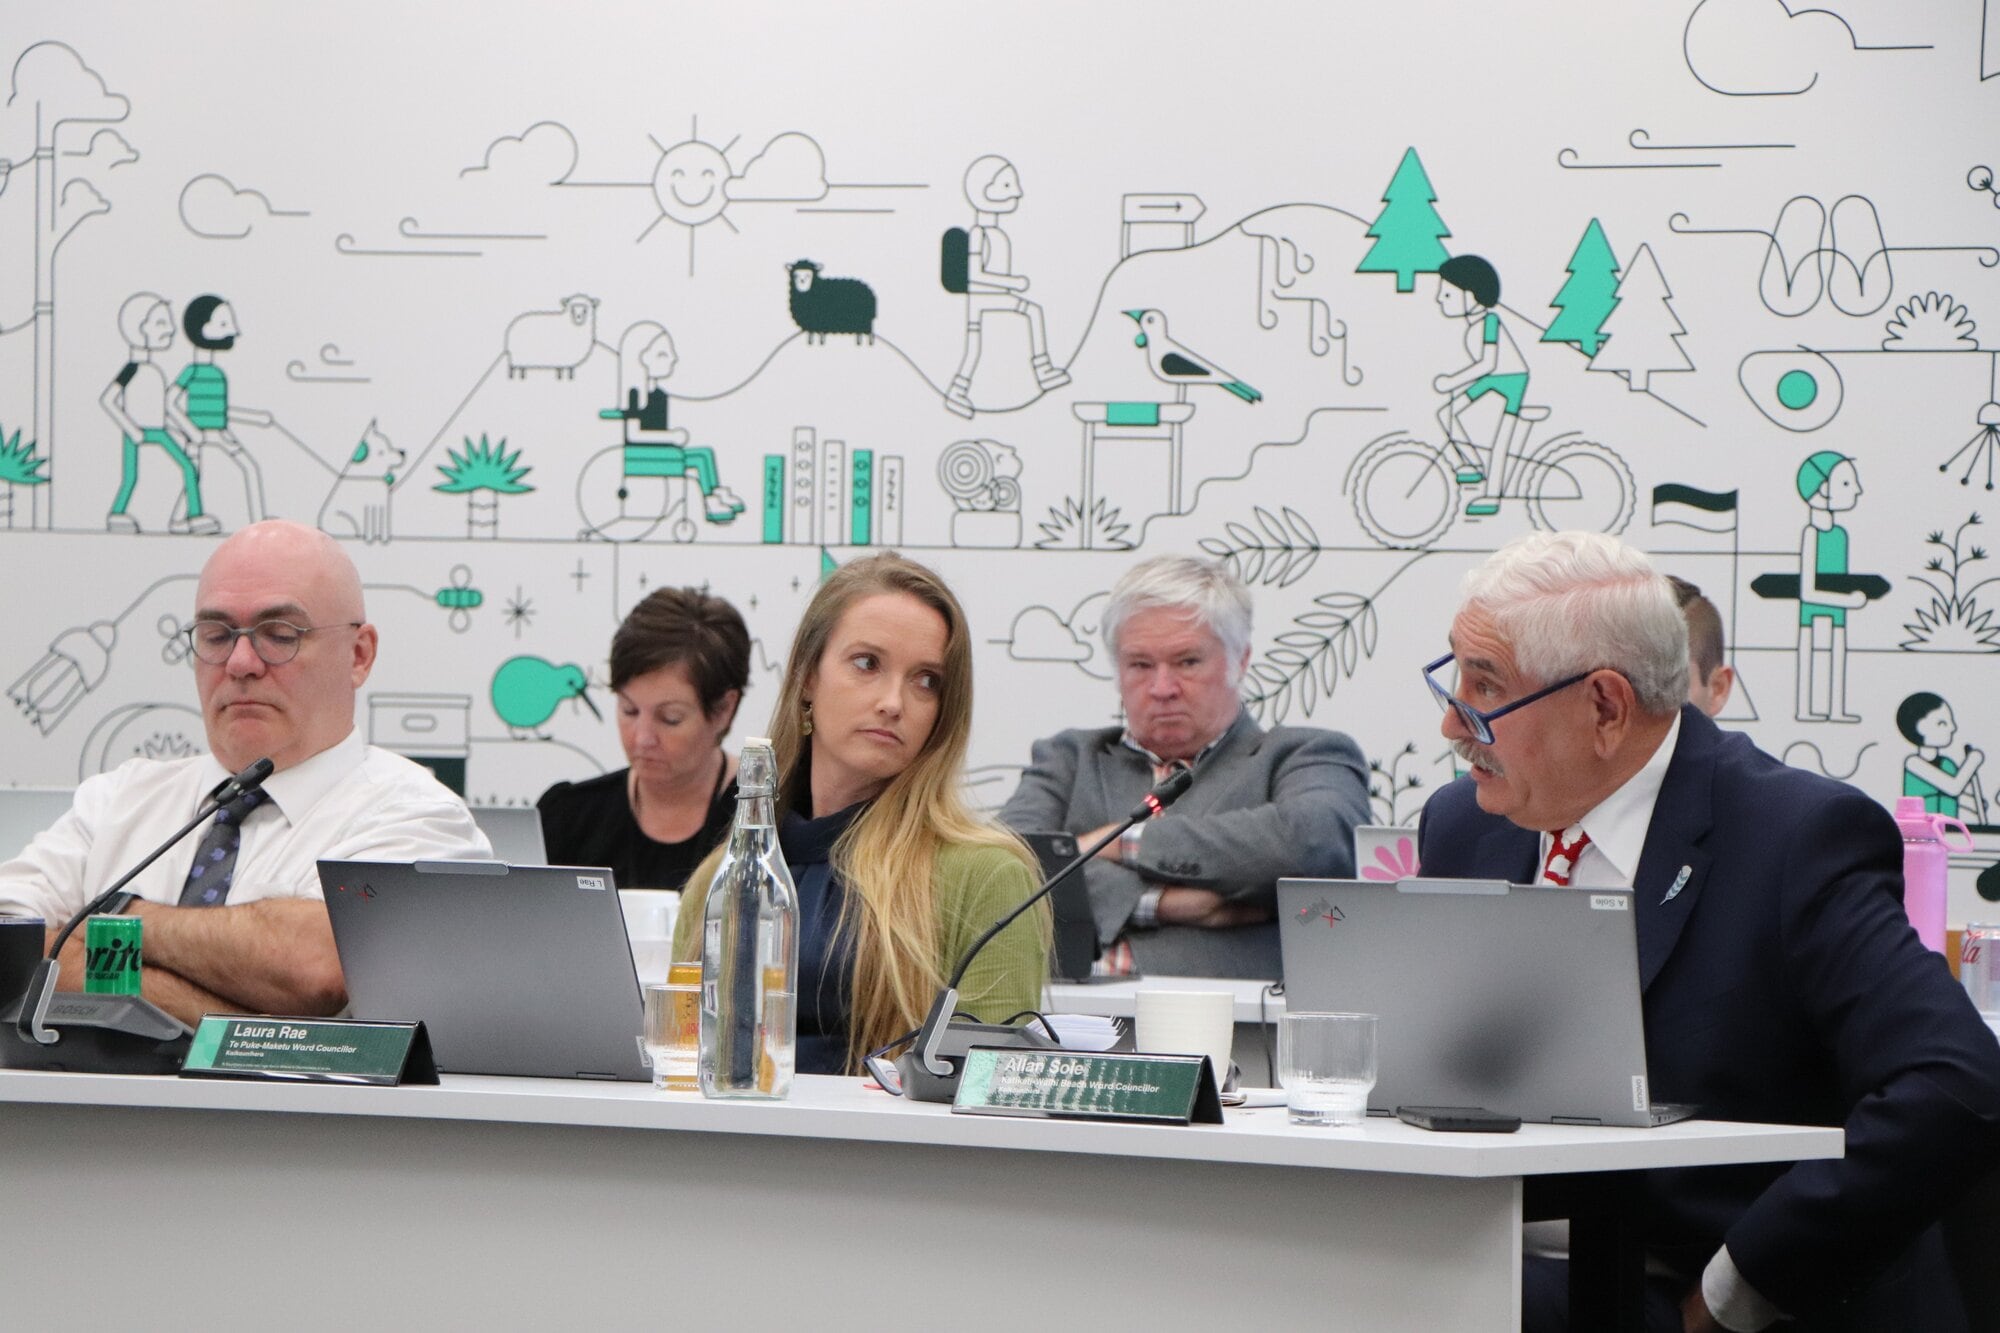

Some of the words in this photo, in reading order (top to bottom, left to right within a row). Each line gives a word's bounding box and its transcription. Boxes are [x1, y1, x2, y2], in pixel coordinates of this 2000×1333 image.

[579, 879, 595, 887] Rae
[1595, 898, 1615, 908] Sole
[1618, 899, 1625, 907] A
[1321, 905, 1345, 928] X1
[233, 1023, 276, 1038] Laura
[278, 1025, 307, 1040] Rae
[229, 1040, 239, 1049] Te
[240, 1040, 291, 1051] Puke-Maketu
[292, 1043, 316, 1052] Ward
[316, 1044, 358, 1053] Councillor
[1004, 1057, 1046, 1073] Allan
[1048, 1058, 1084, 1075] Sole
[1060, 1079, 1087, 1088] Beach
[1089, 1080, 1114, 1090] Ward
[1115, 1082, 1160, 1093] Councillor
[1635, 1078, 1643, 1109] Lenovo
